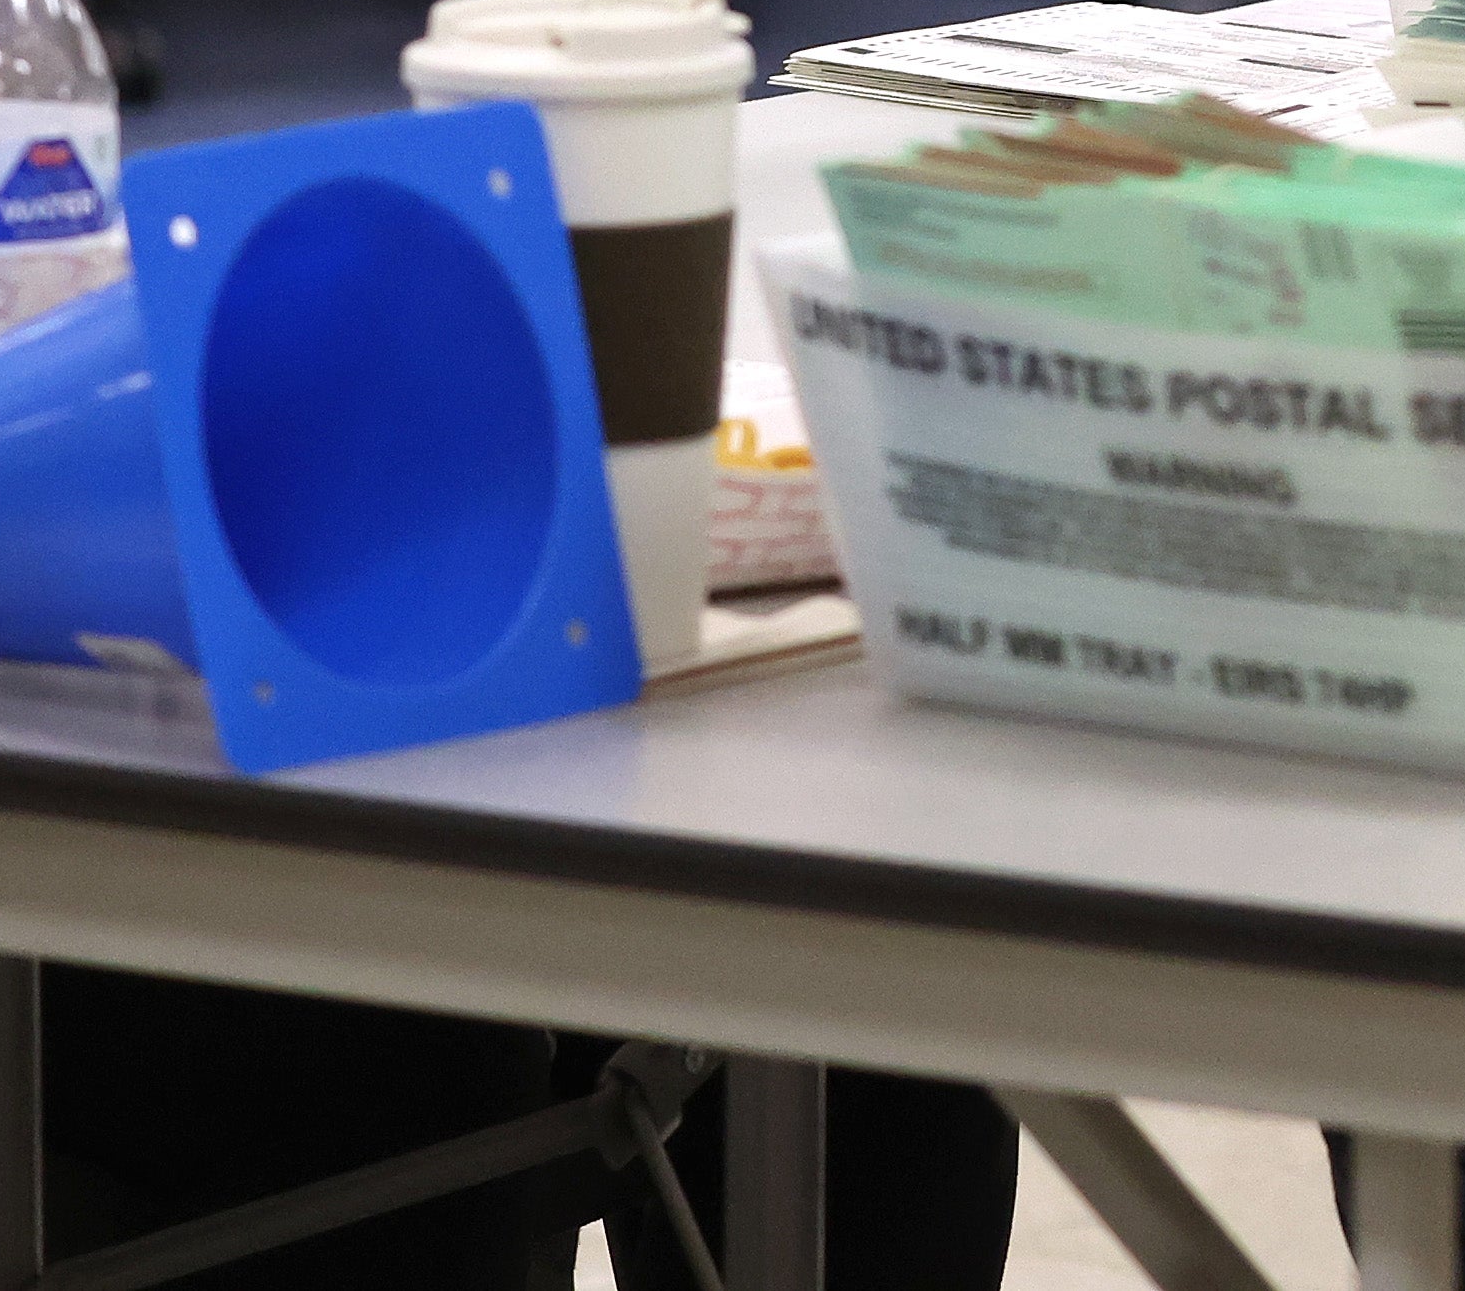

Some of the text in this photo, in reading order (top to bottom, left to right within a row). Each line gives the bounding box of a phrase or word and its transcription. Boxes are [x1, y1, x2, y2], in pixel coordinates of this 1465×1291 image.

[789, 291, 946, 373] UNITED
[955, 331, 1152, 415] STATES
[1163, 368, 1393, 443] POSTAL
[1101, 444, 1298, 504] WARNING
[893, 605, 994, 657] HALF
[1075, 634, 1179, 686] TRAY
